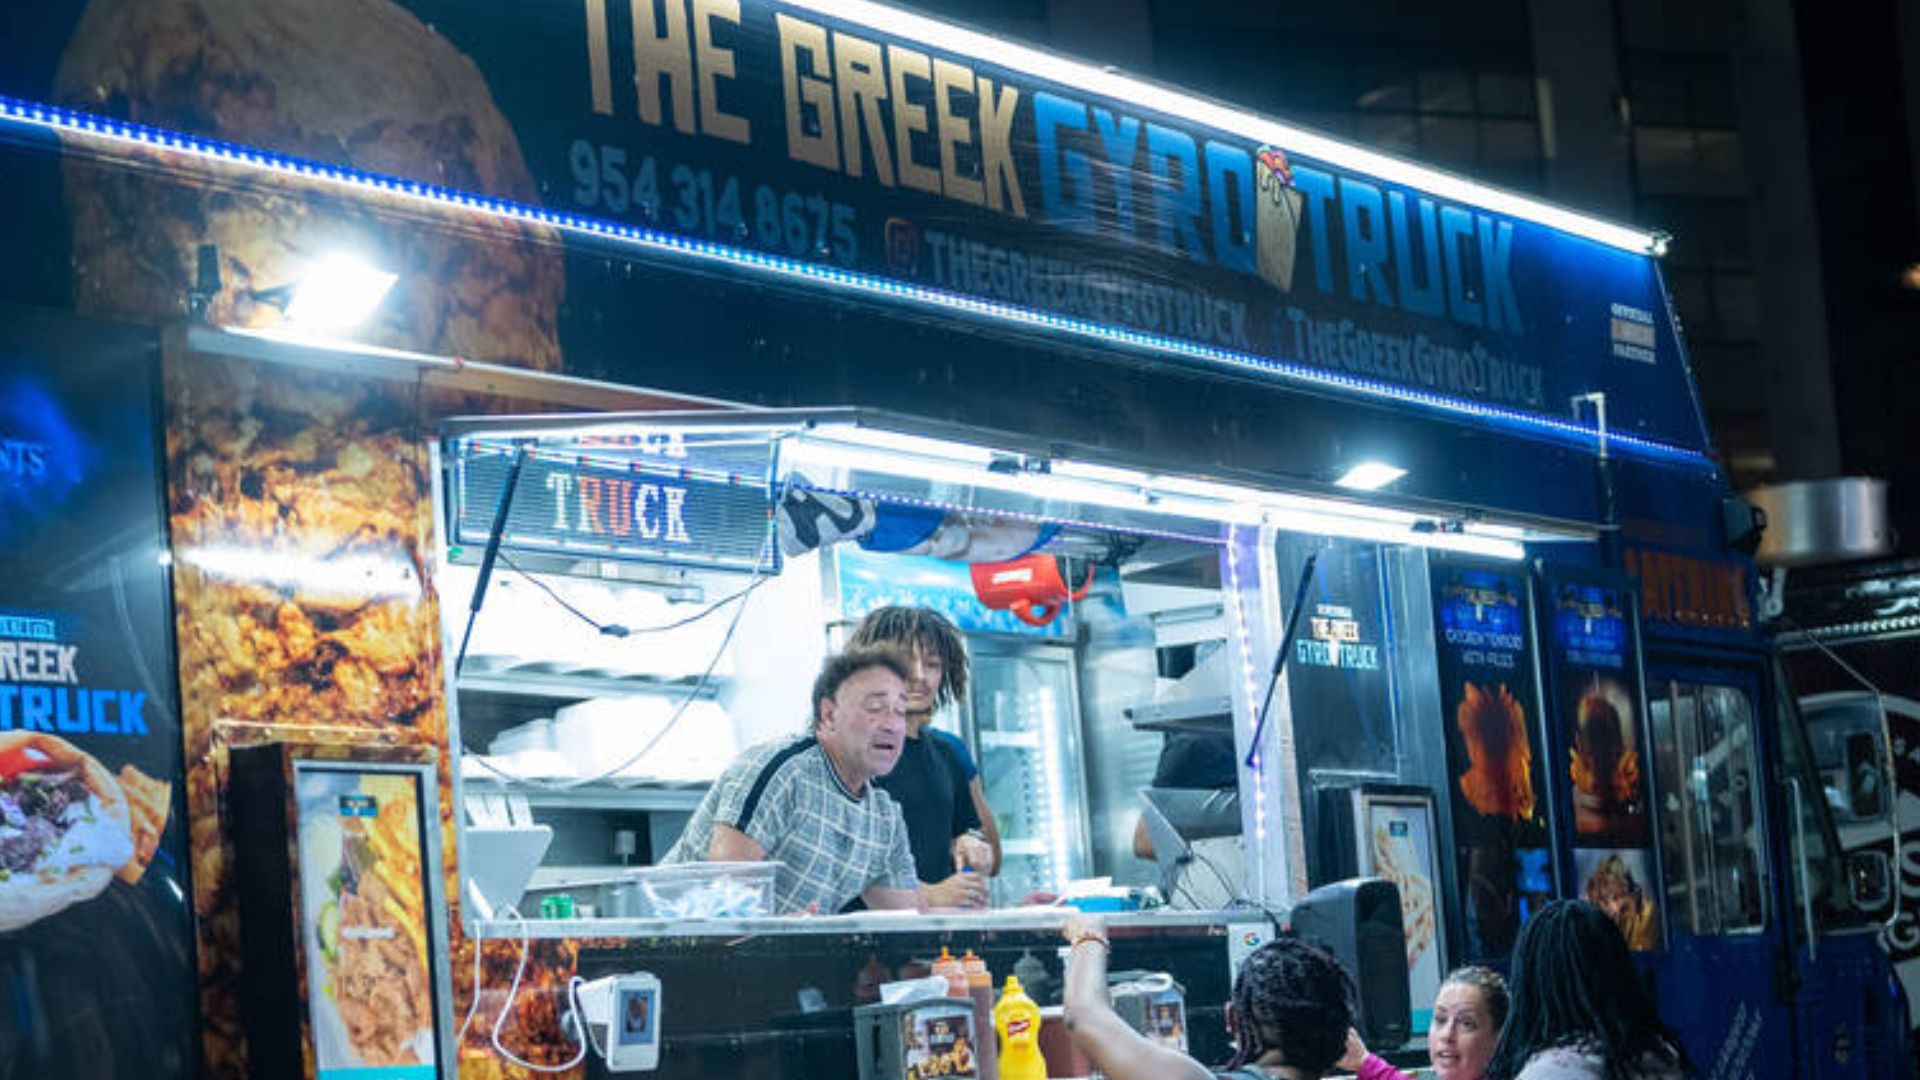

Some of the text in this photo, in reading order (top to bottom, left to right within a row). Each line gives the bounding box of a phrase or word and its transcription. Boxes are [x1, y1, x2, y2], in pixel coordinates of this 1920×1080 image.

[570, 138, 858, 264] 954 314 8675
[585, 0, 1525, 334] THE GREEK GYRO TRUCK
[546, 472, 692, 543] TRUCK
[0, 684, 149, 737] TRUCK
